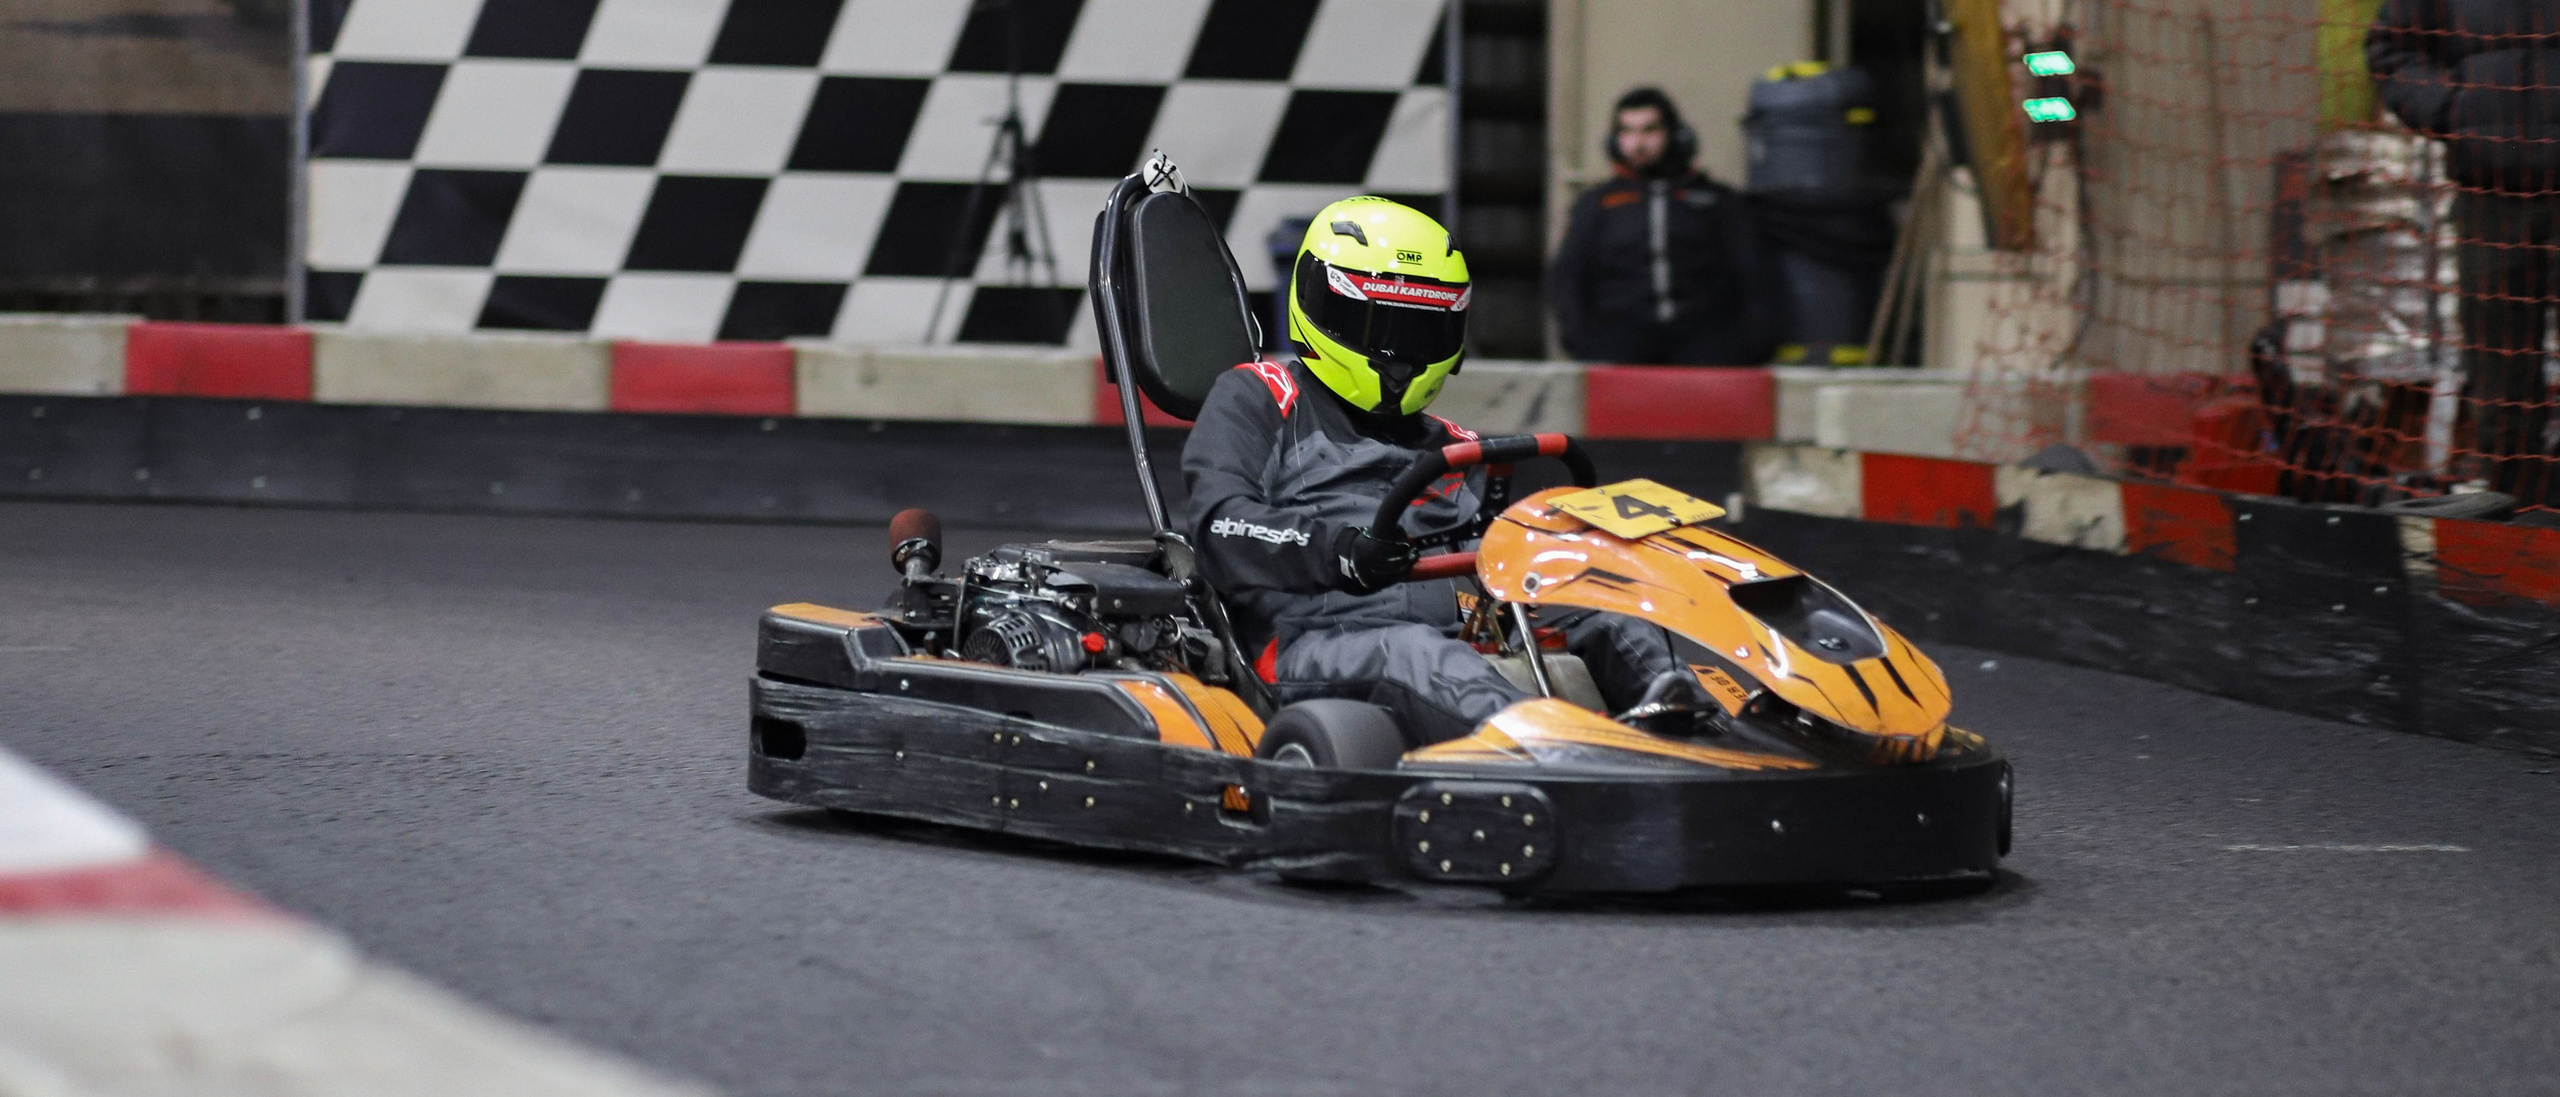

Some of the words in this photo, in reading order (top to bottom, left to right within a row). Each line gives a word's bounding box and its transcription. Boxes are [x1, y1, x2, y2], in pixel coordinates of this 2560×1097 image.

[1396, 252, 1422, 262] OMP
[1362, 282, 1399, 294] DUBAI
[1400, 286, 1458, 302] KARTDROME
[1611, 494, 1678, 520] 4
